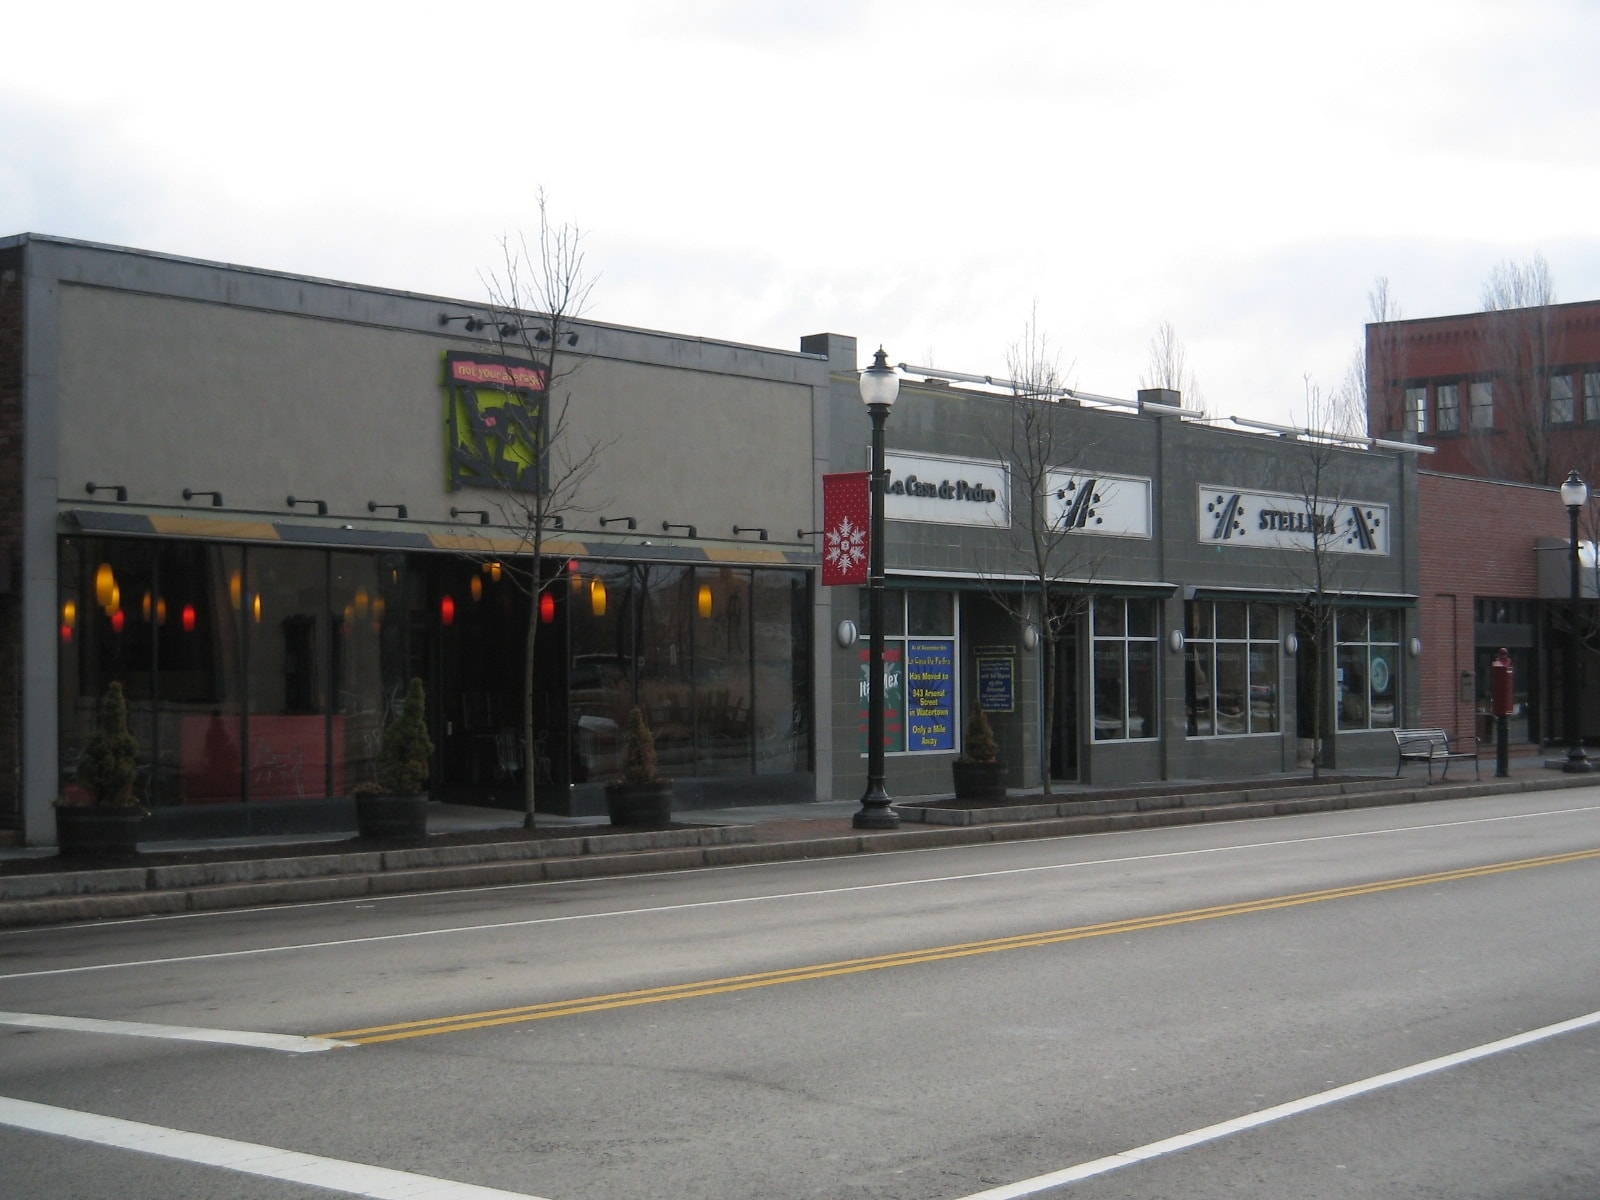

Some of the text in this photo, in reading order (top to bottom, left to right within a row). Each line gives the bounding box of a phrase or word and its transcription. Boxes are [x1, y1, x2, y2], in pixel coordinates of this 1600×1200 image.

[458, 366, 477, 377] not
[478, 369, 501, 380] your
[884, 468, 997, 503] La Casa de Pedro
[1259, 509, 1336, 534] STELLINA
[909, 672, 920, 680] Has
[922, 672, 941, 680] Moved
[920, 697, 938, 706] Street
[916, 708, 949, 717] Watertown
[912, 725, 926, 735] Only
[932, 725, 946, 733] Mile
[921, 736, 937, 747] Away
